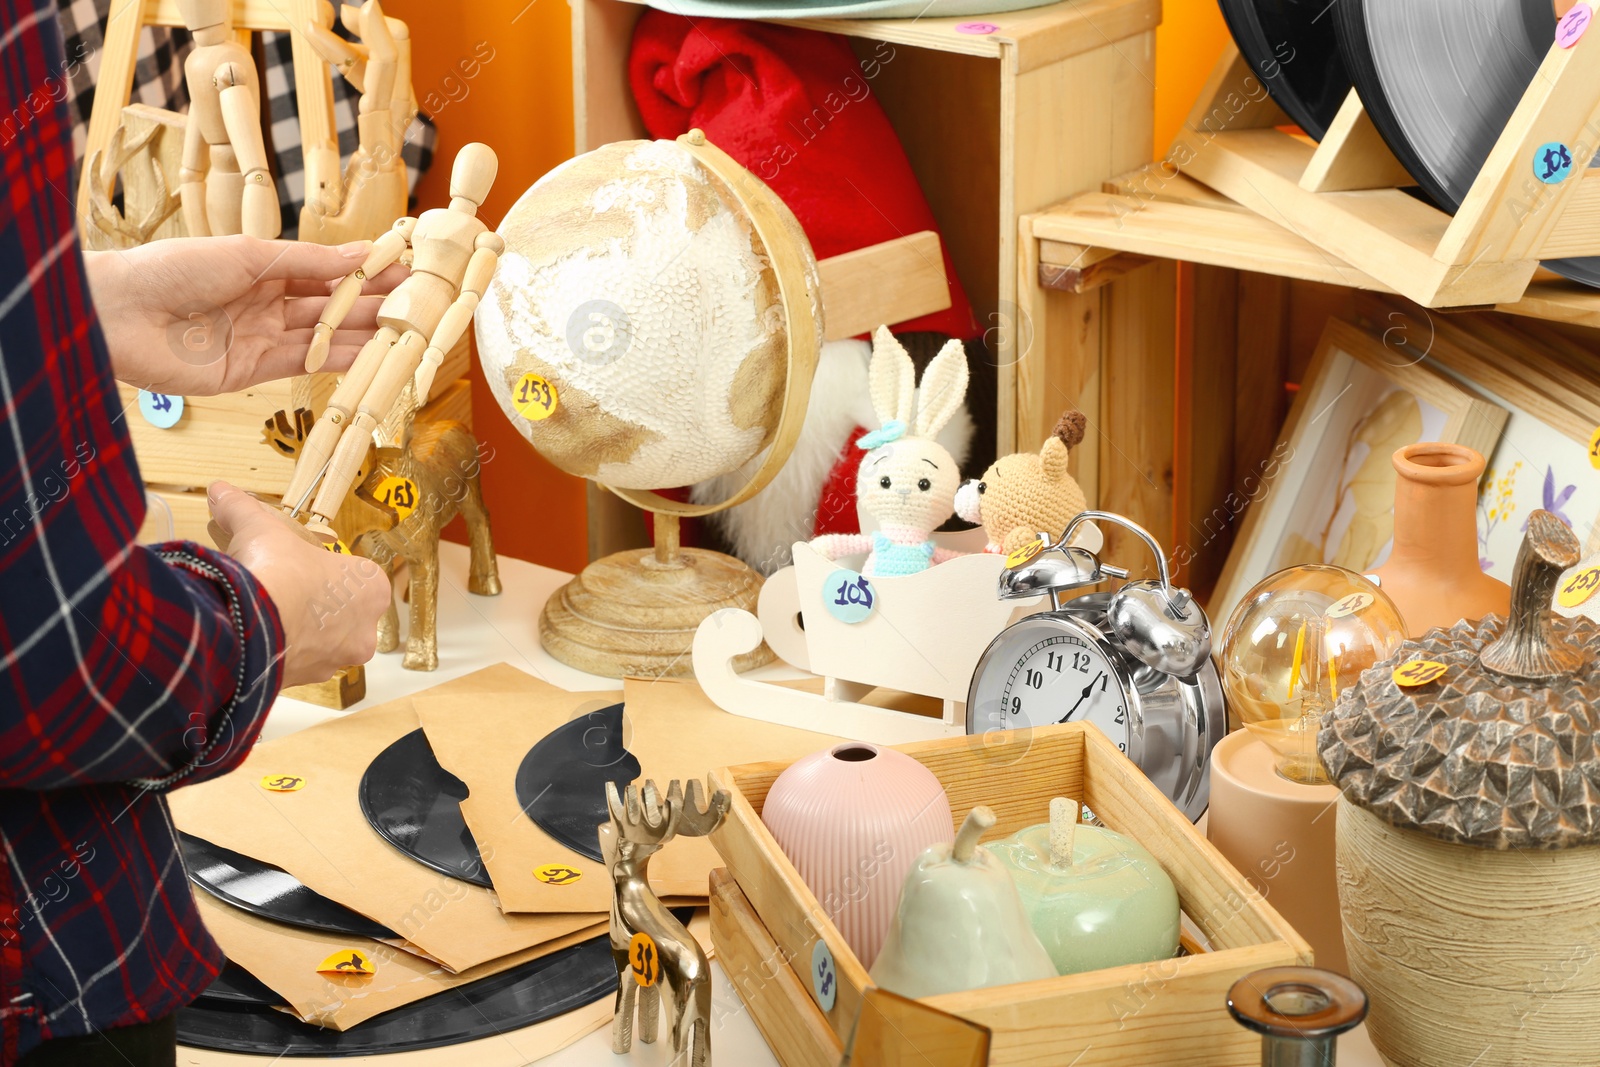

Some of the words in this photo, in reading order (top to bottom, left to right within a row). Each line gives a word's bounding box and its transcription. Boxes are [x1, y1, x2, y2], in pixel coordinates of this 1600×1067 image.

[1046, 651, 1064, 673] 11
[1071, 651, 1091, 674] 12
[1025, 668, 1043, 689] 10
[1100, 673, 1109, 692] 1
[1011, 696, 1022, 715] 9
[1114, 705, 1125, 725] 2
